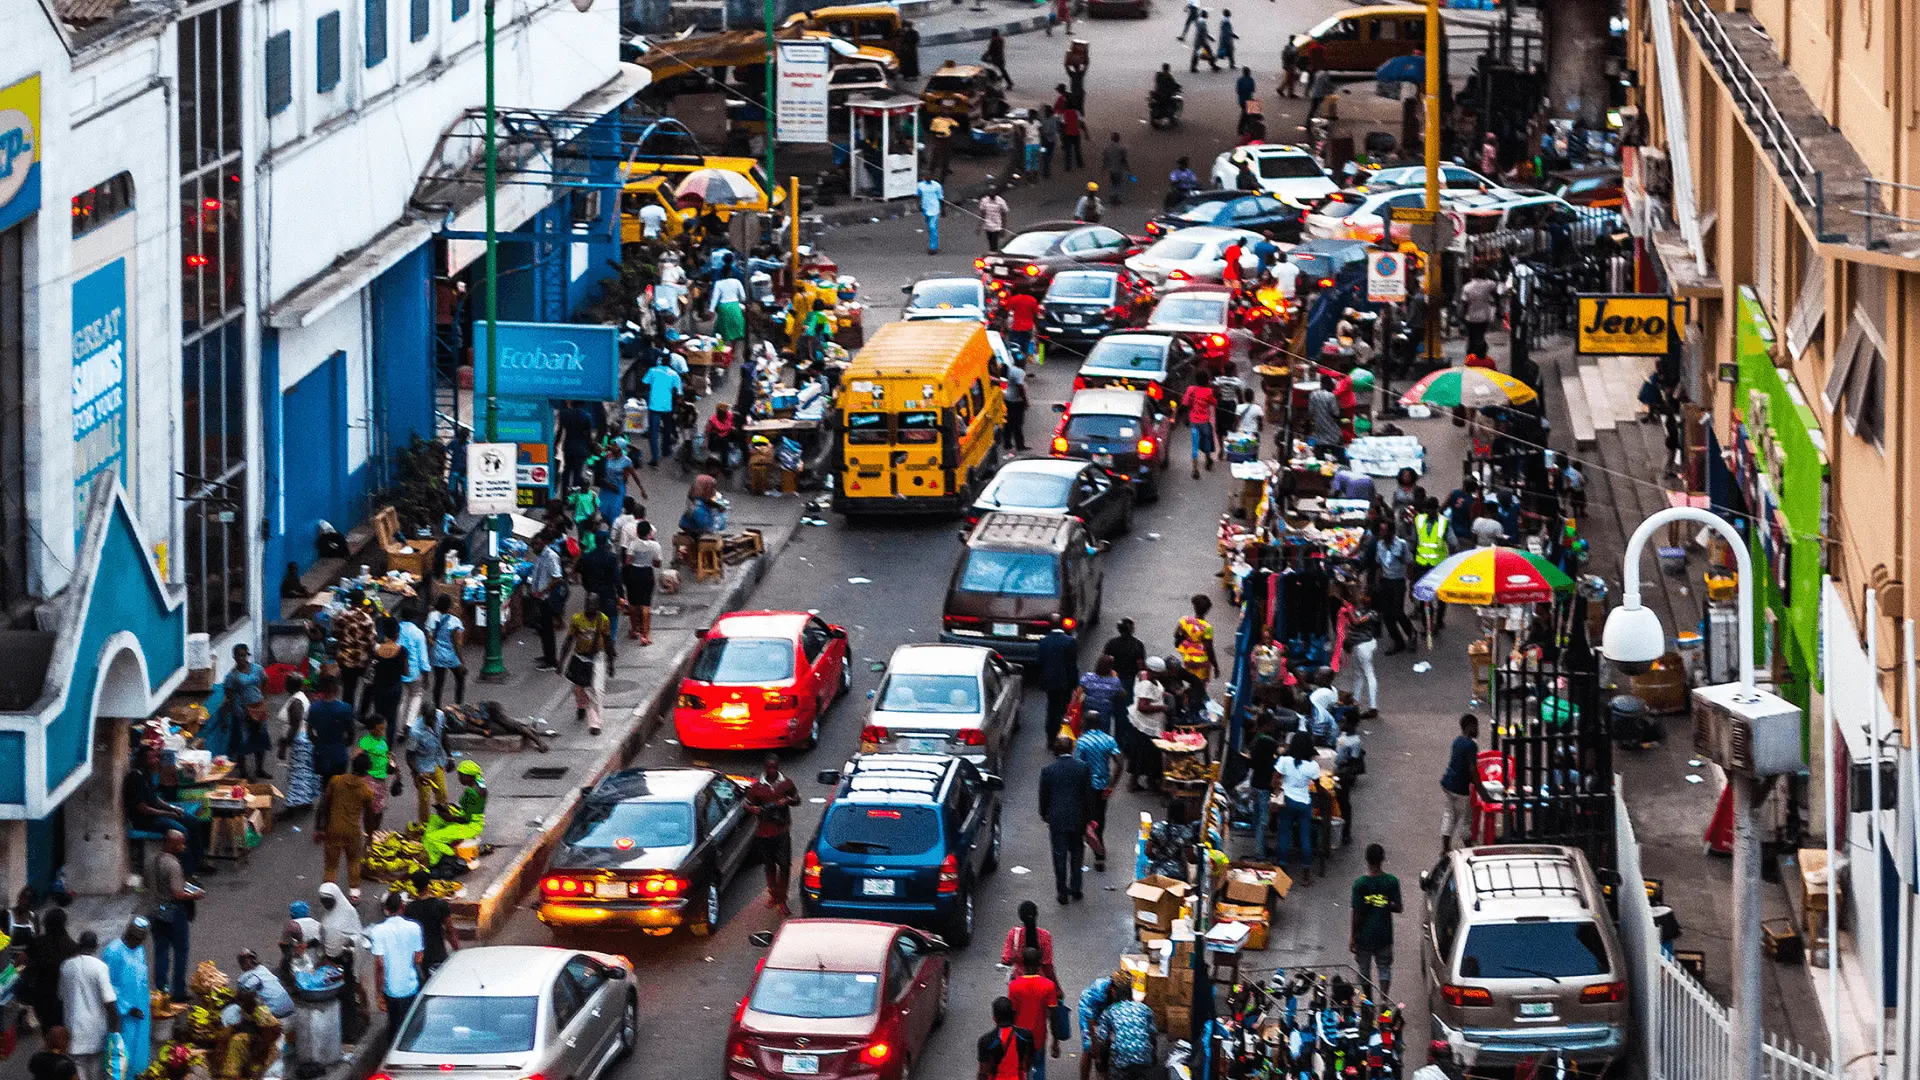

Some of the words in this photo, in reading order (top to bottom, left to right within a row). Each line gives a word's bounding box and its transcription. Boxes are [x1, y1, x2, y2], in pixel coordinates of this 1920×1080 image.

[73, 306, 120, 359] GREAT
[1584, 299, 1665, 335] Jevo
[500, 341, 586, 370] Ecobank
